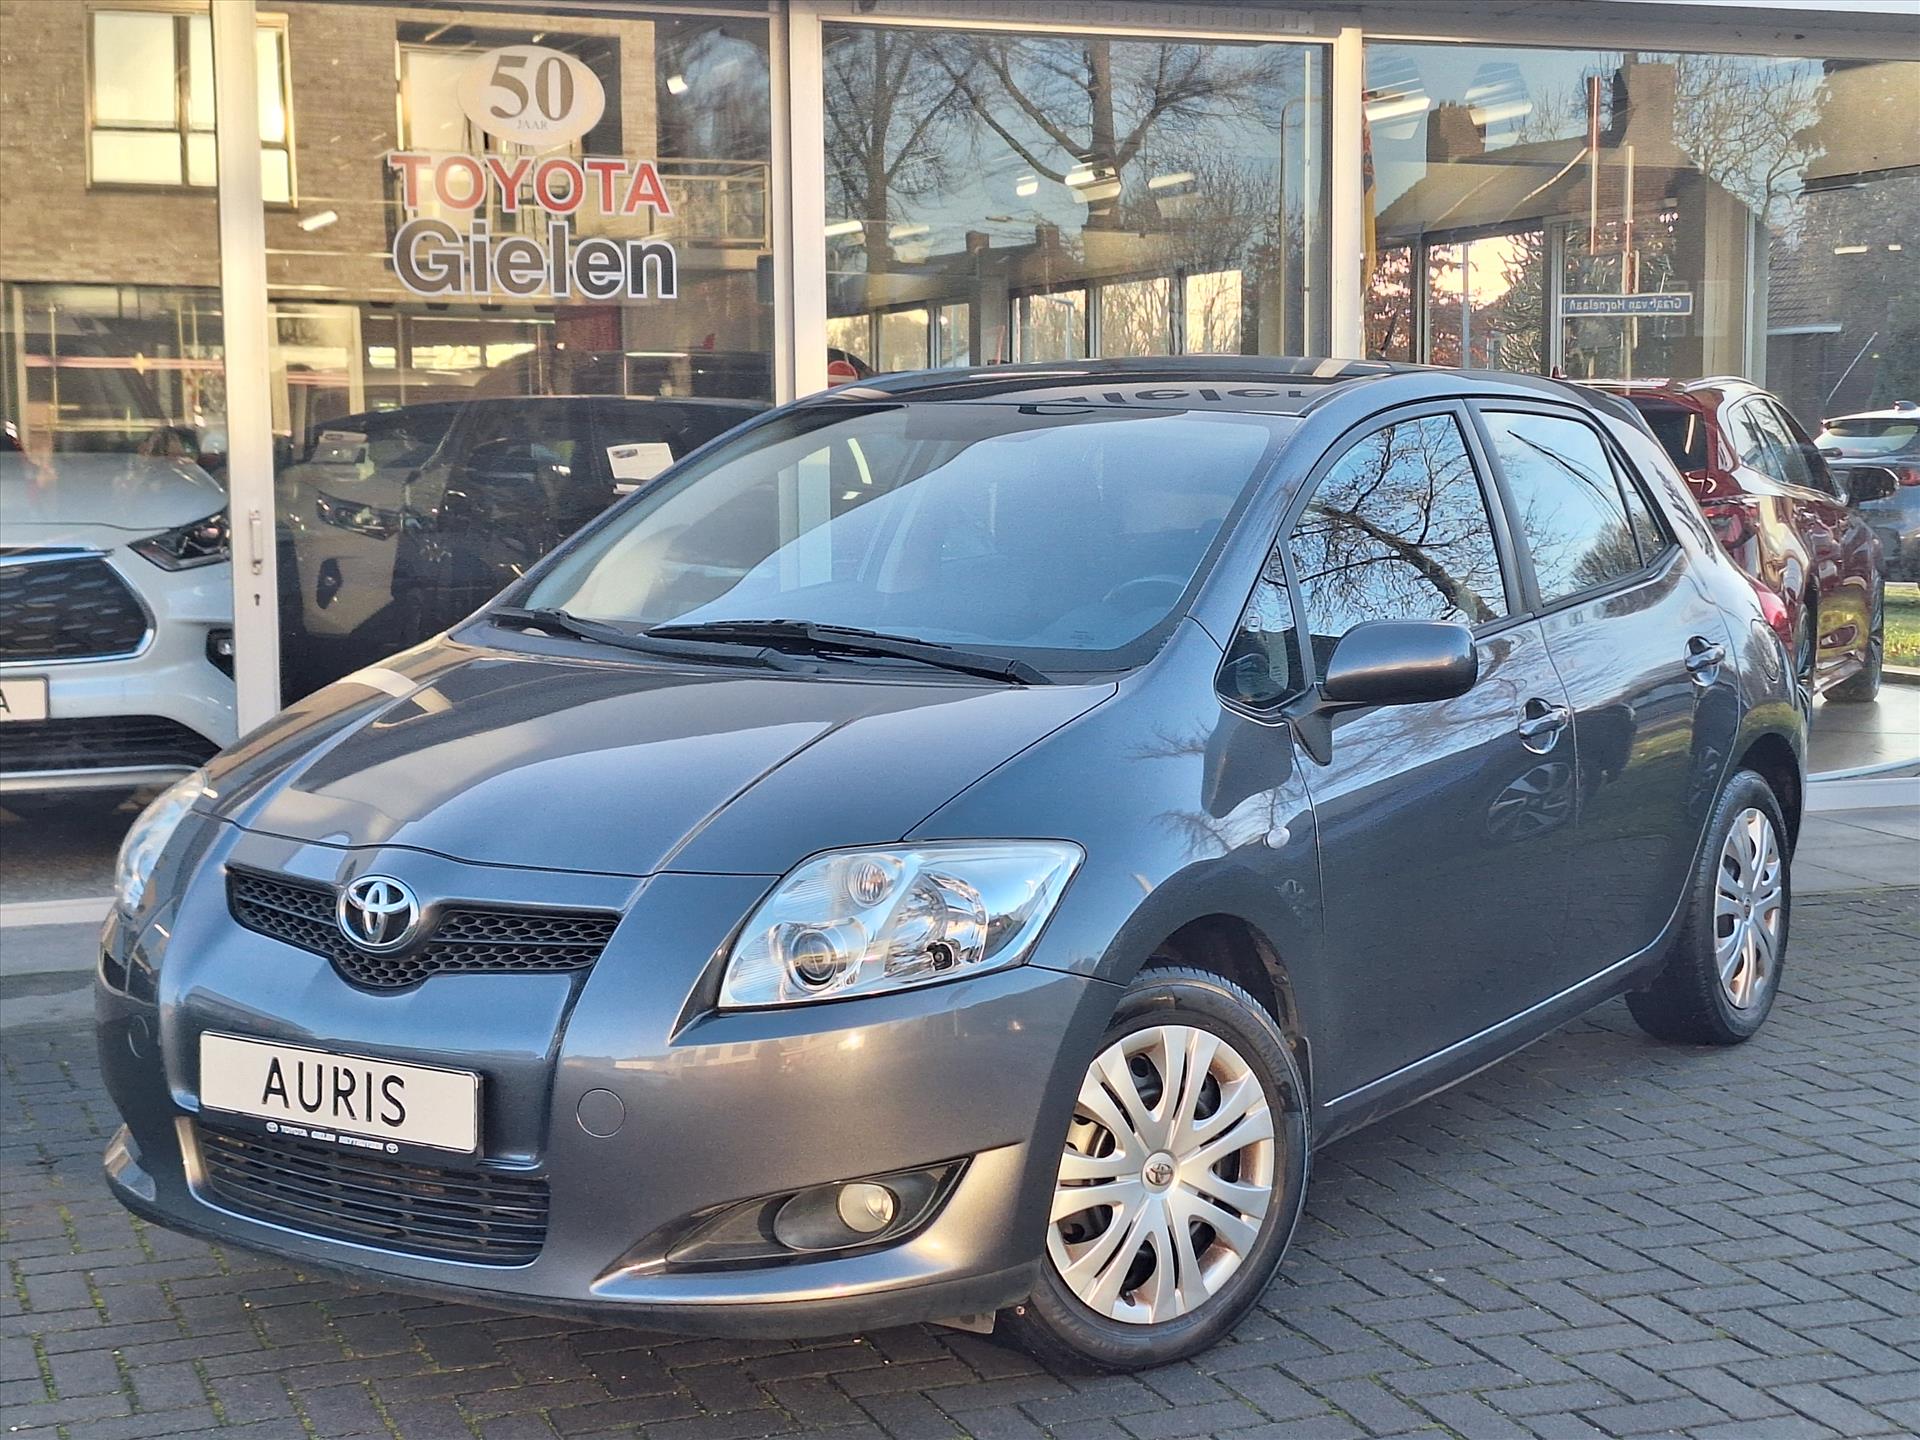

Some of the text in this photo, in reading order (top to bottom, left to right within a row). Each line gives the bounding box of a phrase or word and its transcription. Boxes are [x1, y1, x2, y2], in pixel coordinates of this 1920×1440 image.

[489, 54, 575, 122] 50
[516, 119, 550, 131] JAAR
[388, 152, 674, 217] TOYOTA
[393, 218, 677, 299] Gielen
[261, 1056, 406, 1128] AURIS
